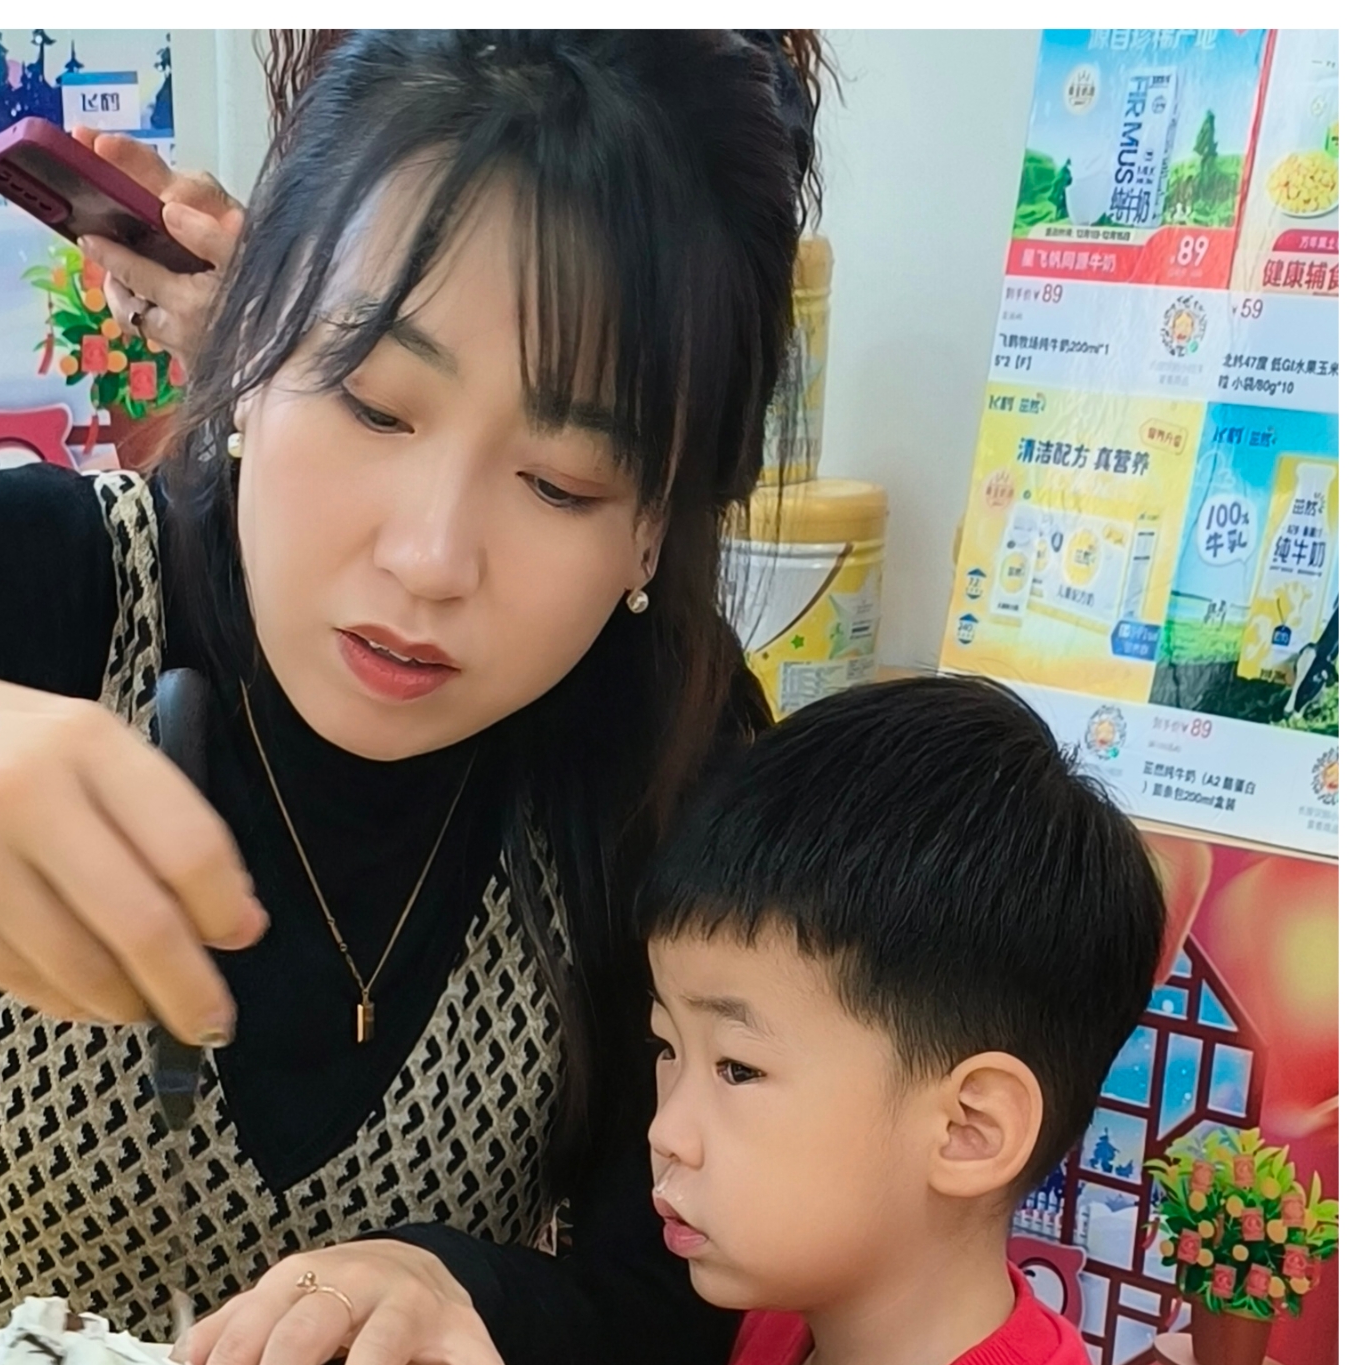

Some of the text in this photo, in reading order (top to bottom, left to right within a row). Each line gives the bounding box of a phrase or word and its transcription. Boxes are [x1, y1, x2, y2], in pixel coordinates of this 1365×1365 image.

[1115, 76, 1149, 184] FIRMUS
[1016, 436, 1150, 476] 清洁配方 真营养
[1205, 529, 1249, 559] 牛乳
[1272, 535, 1327, 569] 纯牛奶
